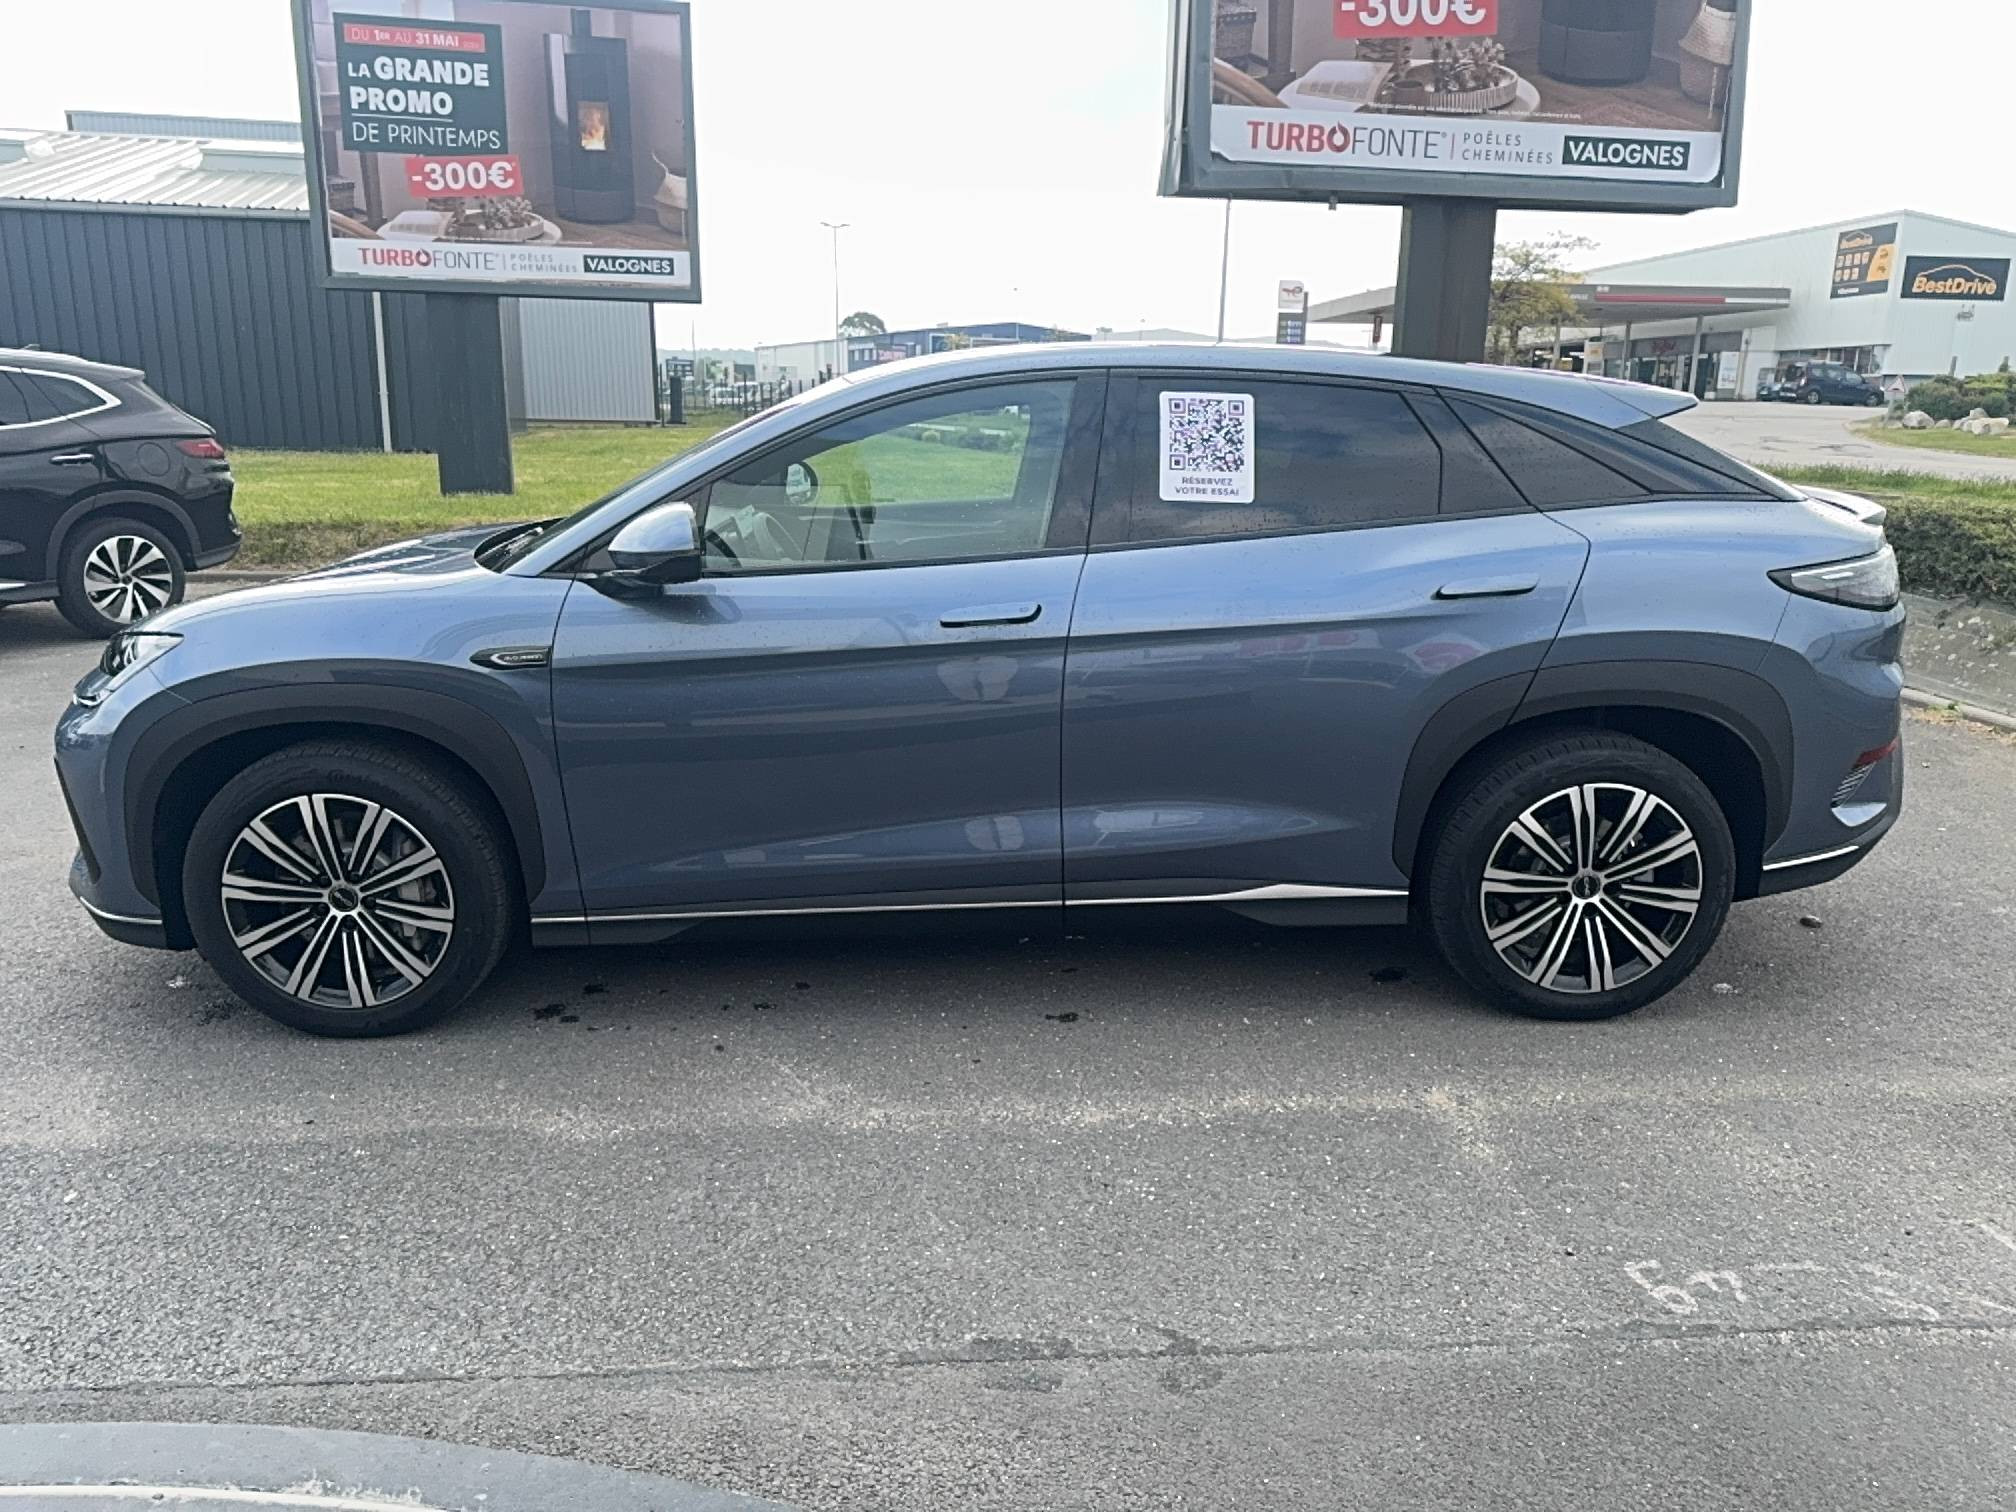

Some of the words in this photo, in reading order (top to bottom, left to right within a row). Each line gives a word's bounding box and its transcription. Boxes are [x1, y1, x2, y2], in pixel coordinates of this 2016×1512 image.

[1341, 0, 1487, 27] -300€
[351, 28, 369, 40] DU
[394, 32, 412, 44] AU
[415, 32, 430, 45] 31
[433, 34, 459, 47] MAI
[347, 62, 371, 79] LA
[374, 56, 490, 87] GRANDE
[350, 85, 454, 115] PROMO
[352, 122, 380, 143] DE
[388, 123, 501, 149] PRINTEMPS
[1463, 130, 1522, 147] POÊLES
[1462, 149, 1553, 165] CHEMINÉES
[1569, 141, 1685, 167] VALOGNES
[586, 257, 671, 274] VALOGNES
[1912, 276, 1997, 295] BestDrive
[1175, 486, 1208, 496] VOTRE
[1211, 486, 1239, 497] ESSAI
